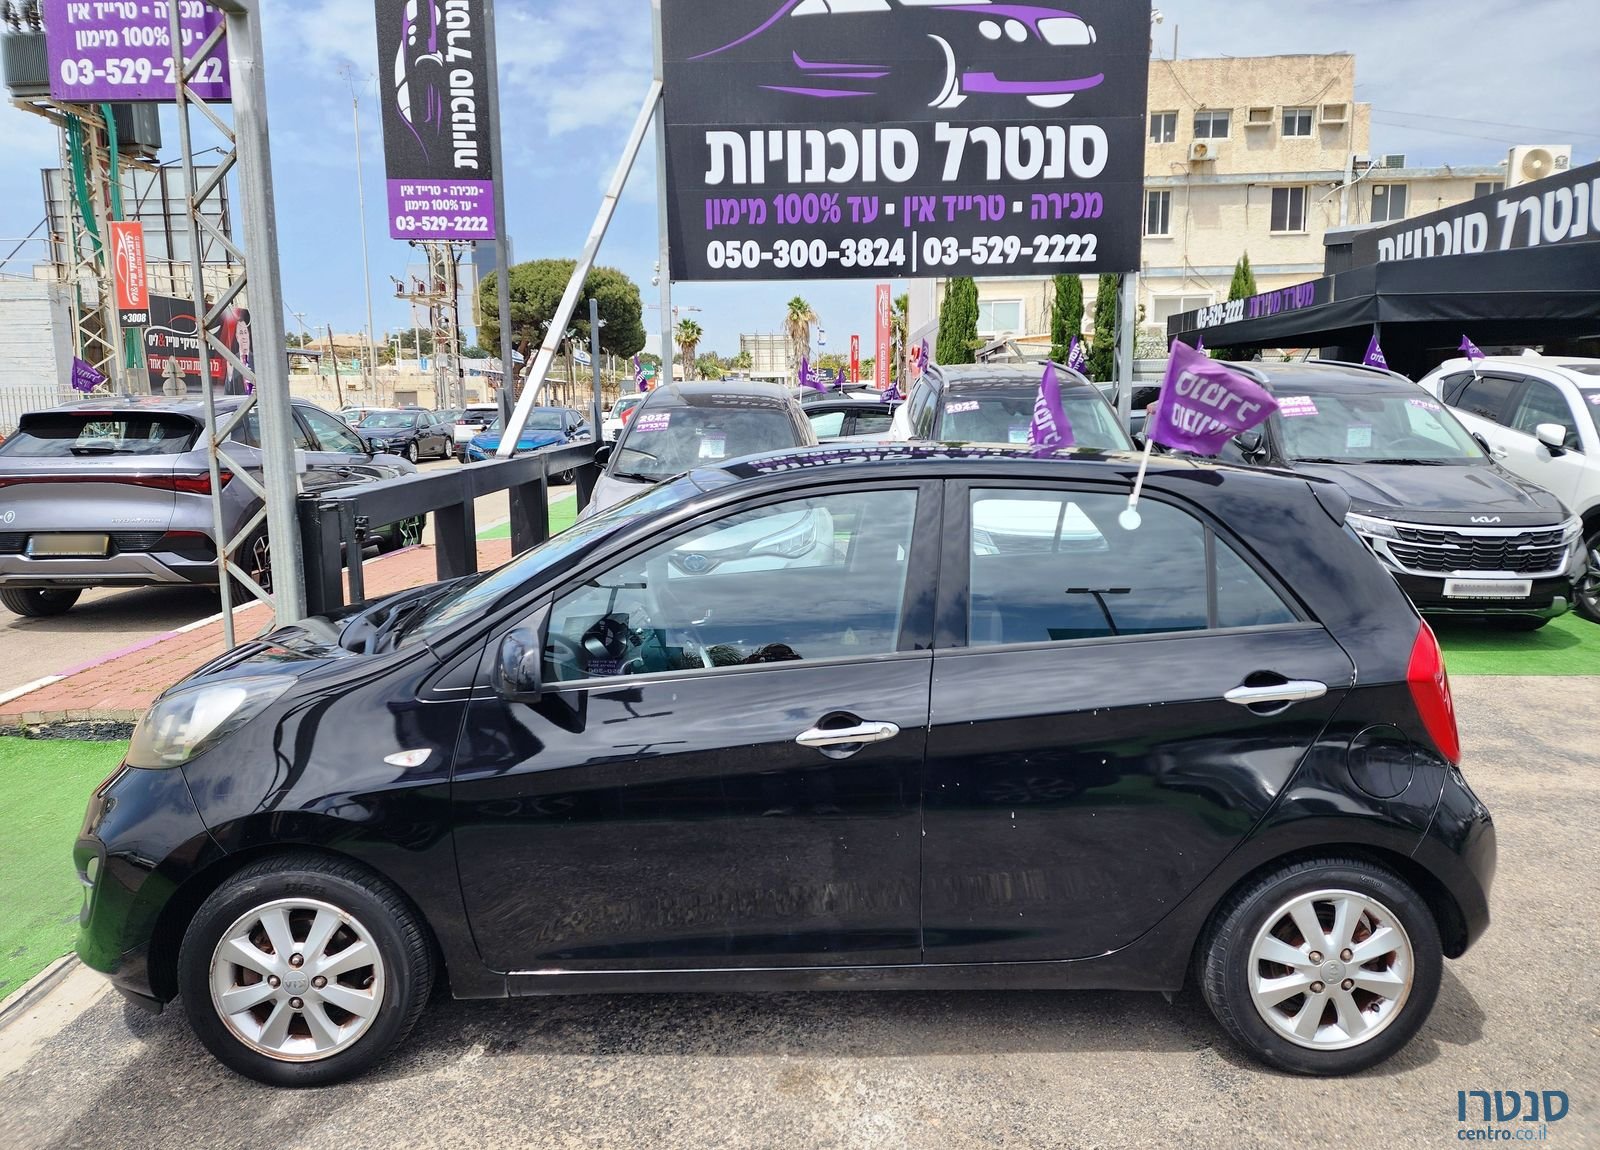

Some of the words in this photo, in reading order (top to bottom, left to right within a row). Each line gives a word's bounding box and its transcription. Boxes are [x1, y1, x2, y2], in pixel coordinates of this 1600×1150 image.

[67, 2, 90, 23] אין
[94, 2, 137, 19] טרייד
[154, 1, 204, 18] מכה
[75, 28, 118, 51] מימון
[122, 27, 169, 47] 100%
[445, 0, 473, 63] נטרל
[449, 68, 479, 170] סוכנויות
[704, 128, 919, 185] סוכנויות
[935, 122, 1109, 182] סנטרל
[400, 186, 414, 198] אין
[417, 186, 441, 196] טרייד
[451, 185, 477, 196] מכירה
[405, 200, 429, 212] מימון
[431, 200, 458, 211] 100%
[459, 200, 471, 211] עד
[705, 197, 767, 230] מימון
[773, 193, 841, 225] 100%
[847, 195, 878, 224] עד
[904, 195, 936, 228] אין
[942, 193, 1005, 223] טרייד
[1031, 191, 1104, 220] מכירה
[1497, 177, 1600, 250] נטרל
[396, 215, 488, 232] 03-529-2222
[1378, 212, 1489, 262] סוכנויות
[706, 236, 905, 269] 050-300-3824
[923, 233, 1098, 266] 03-529-2222
[1249, 292, 1281, 318] מכירות
[1284, 282, 1315, 310] משרד
[1197, 299, 1245, 329] 03-529-2222
[639, 413, 671, 422] 2022
[946, 400, 980, 414] 2022
